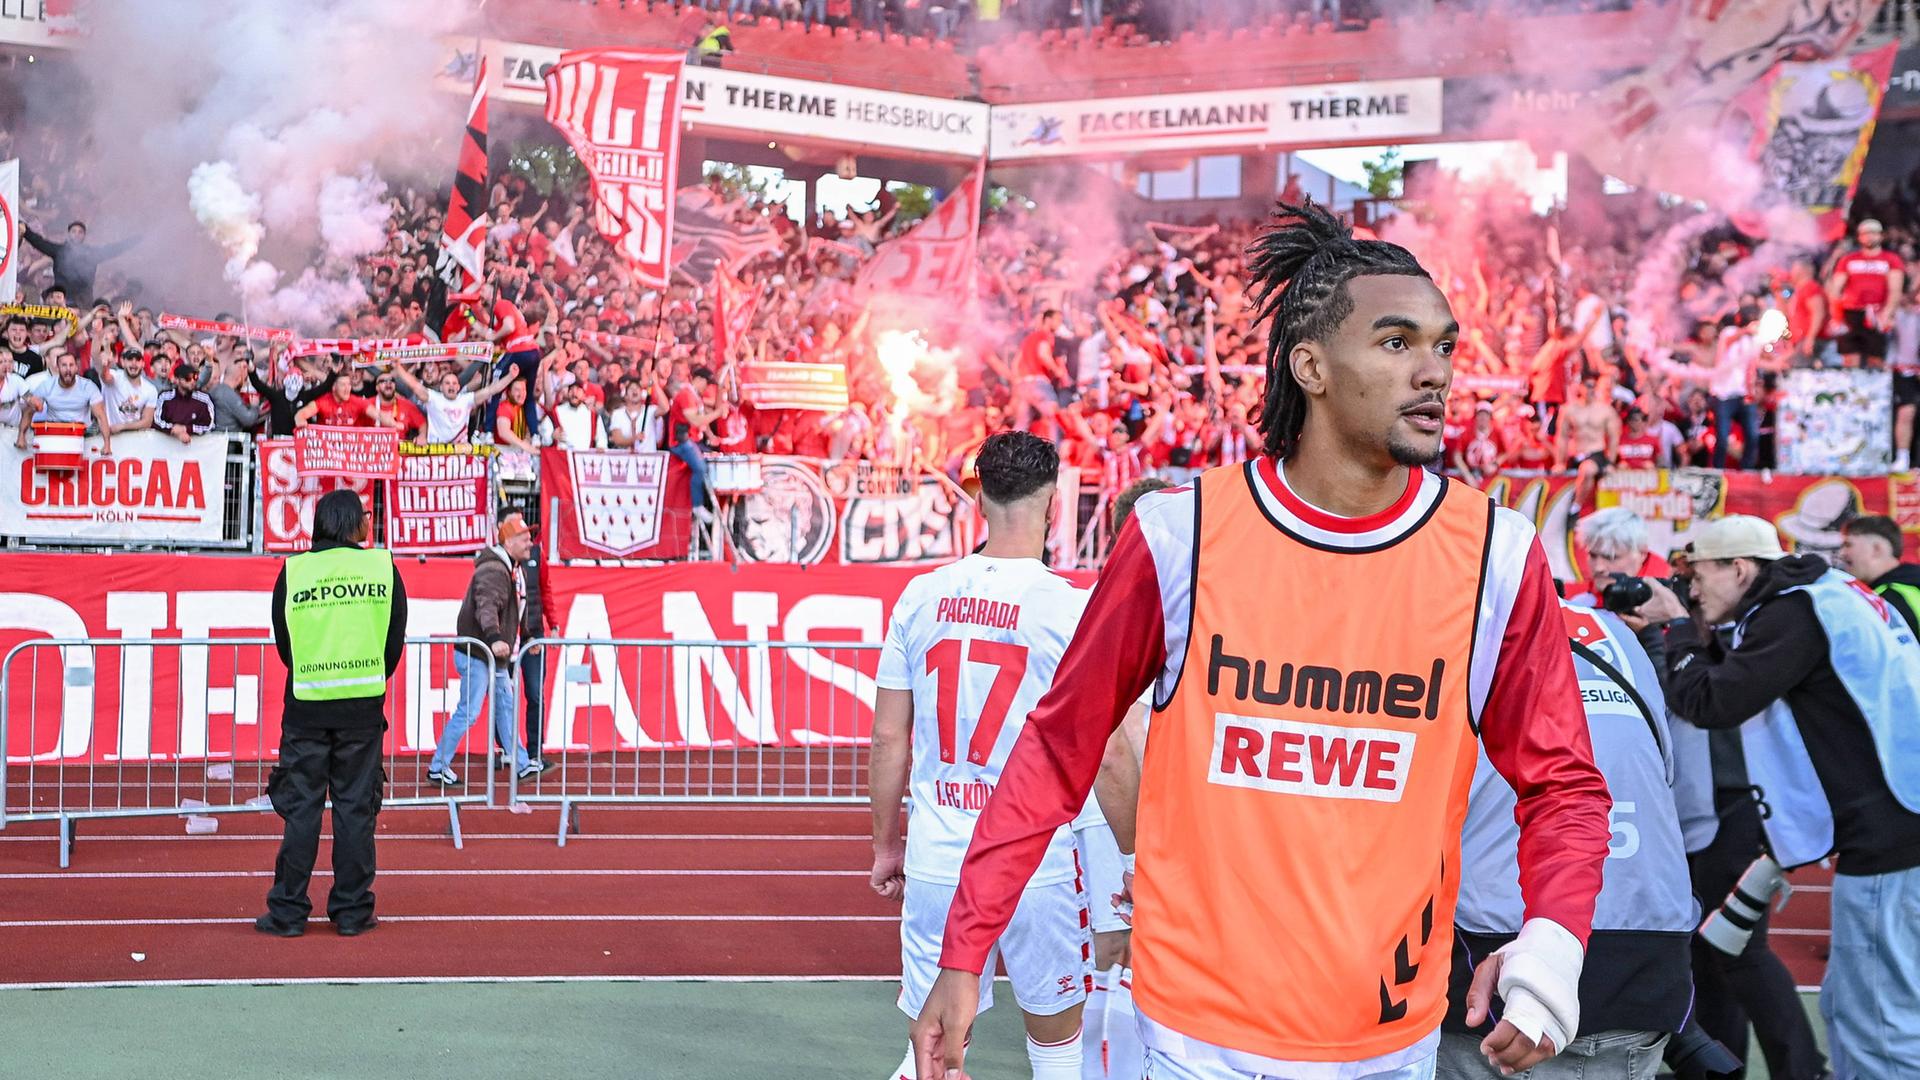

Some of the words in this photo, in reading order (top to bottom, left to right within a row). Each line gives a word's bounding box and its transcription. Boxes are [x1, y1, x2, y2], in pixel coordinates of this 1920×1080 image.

[726, 85, 836, 117] THERME
[847, 103, 973, 134] HERSBRUCK
[1079, 103, 1270, 132] FACKELMANN
[1290, 94, 1409, 121] THERME
[20, 458, 206, 509] CRICCAA
[96, 511, 135, 523] KÖLN
[321, 583, 387, 600] POWER
[936, 597, 1021, 631] PACARADA
[0, 591, 279, 761] DIE
[1208, 633, 1445, 721] hummel
[1581, 689, 1633, 704] ESLIGA
[925, 638, 1029, 767] 17
[1220, 726, 1400, 791] REWE
[935, 779, 960, 809] 1.FC
[963, 778, 995, 810] KÖL
[1612, 801, 1640, 859] 5
